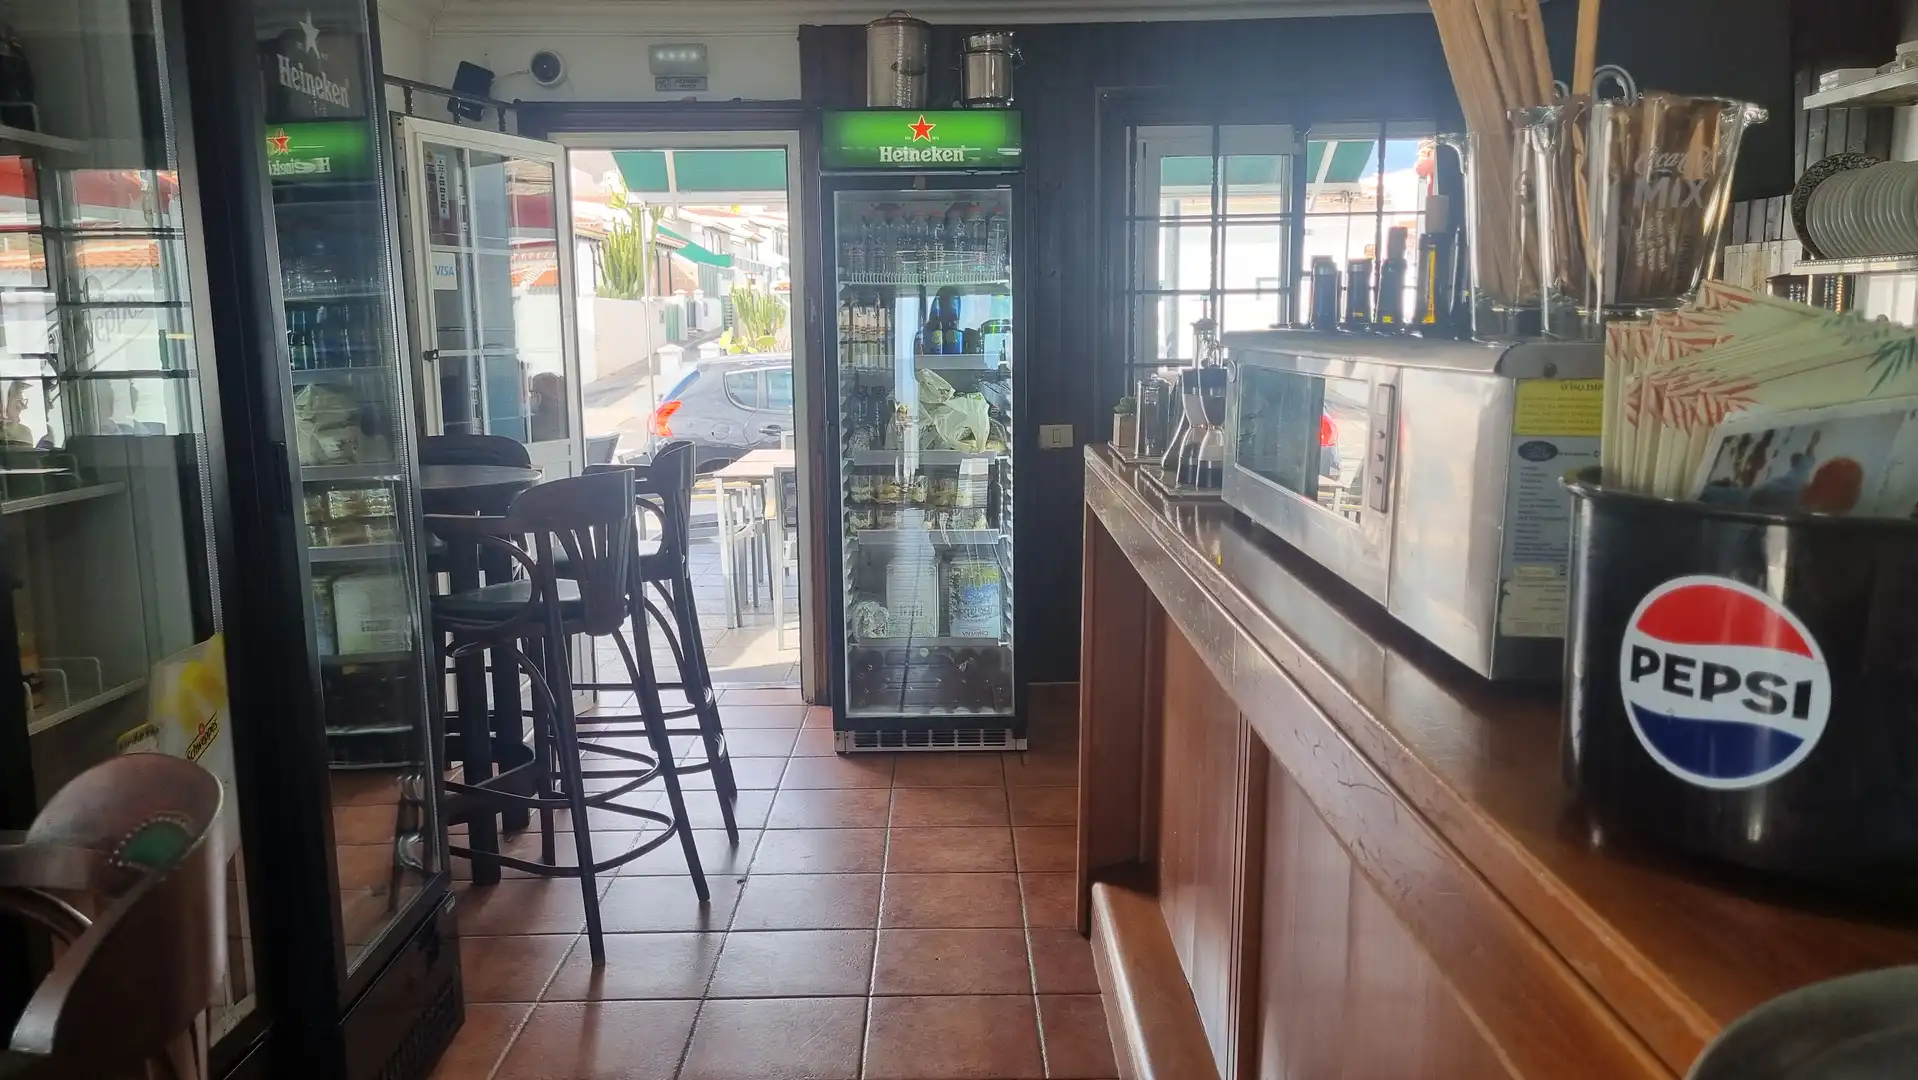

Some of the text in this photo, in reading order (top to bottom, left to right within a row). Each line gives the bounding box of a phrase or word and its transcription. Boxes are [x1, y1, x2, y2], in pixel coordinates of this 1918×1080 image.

[276, 53, 349, 108] Heineken
[879, 146, 965, 163] Heineken
[1633, 176, 1708, 208] MIX
[434, 264, 454, 276] VISA
[1629, 644, 1813, 721] PEPSI
